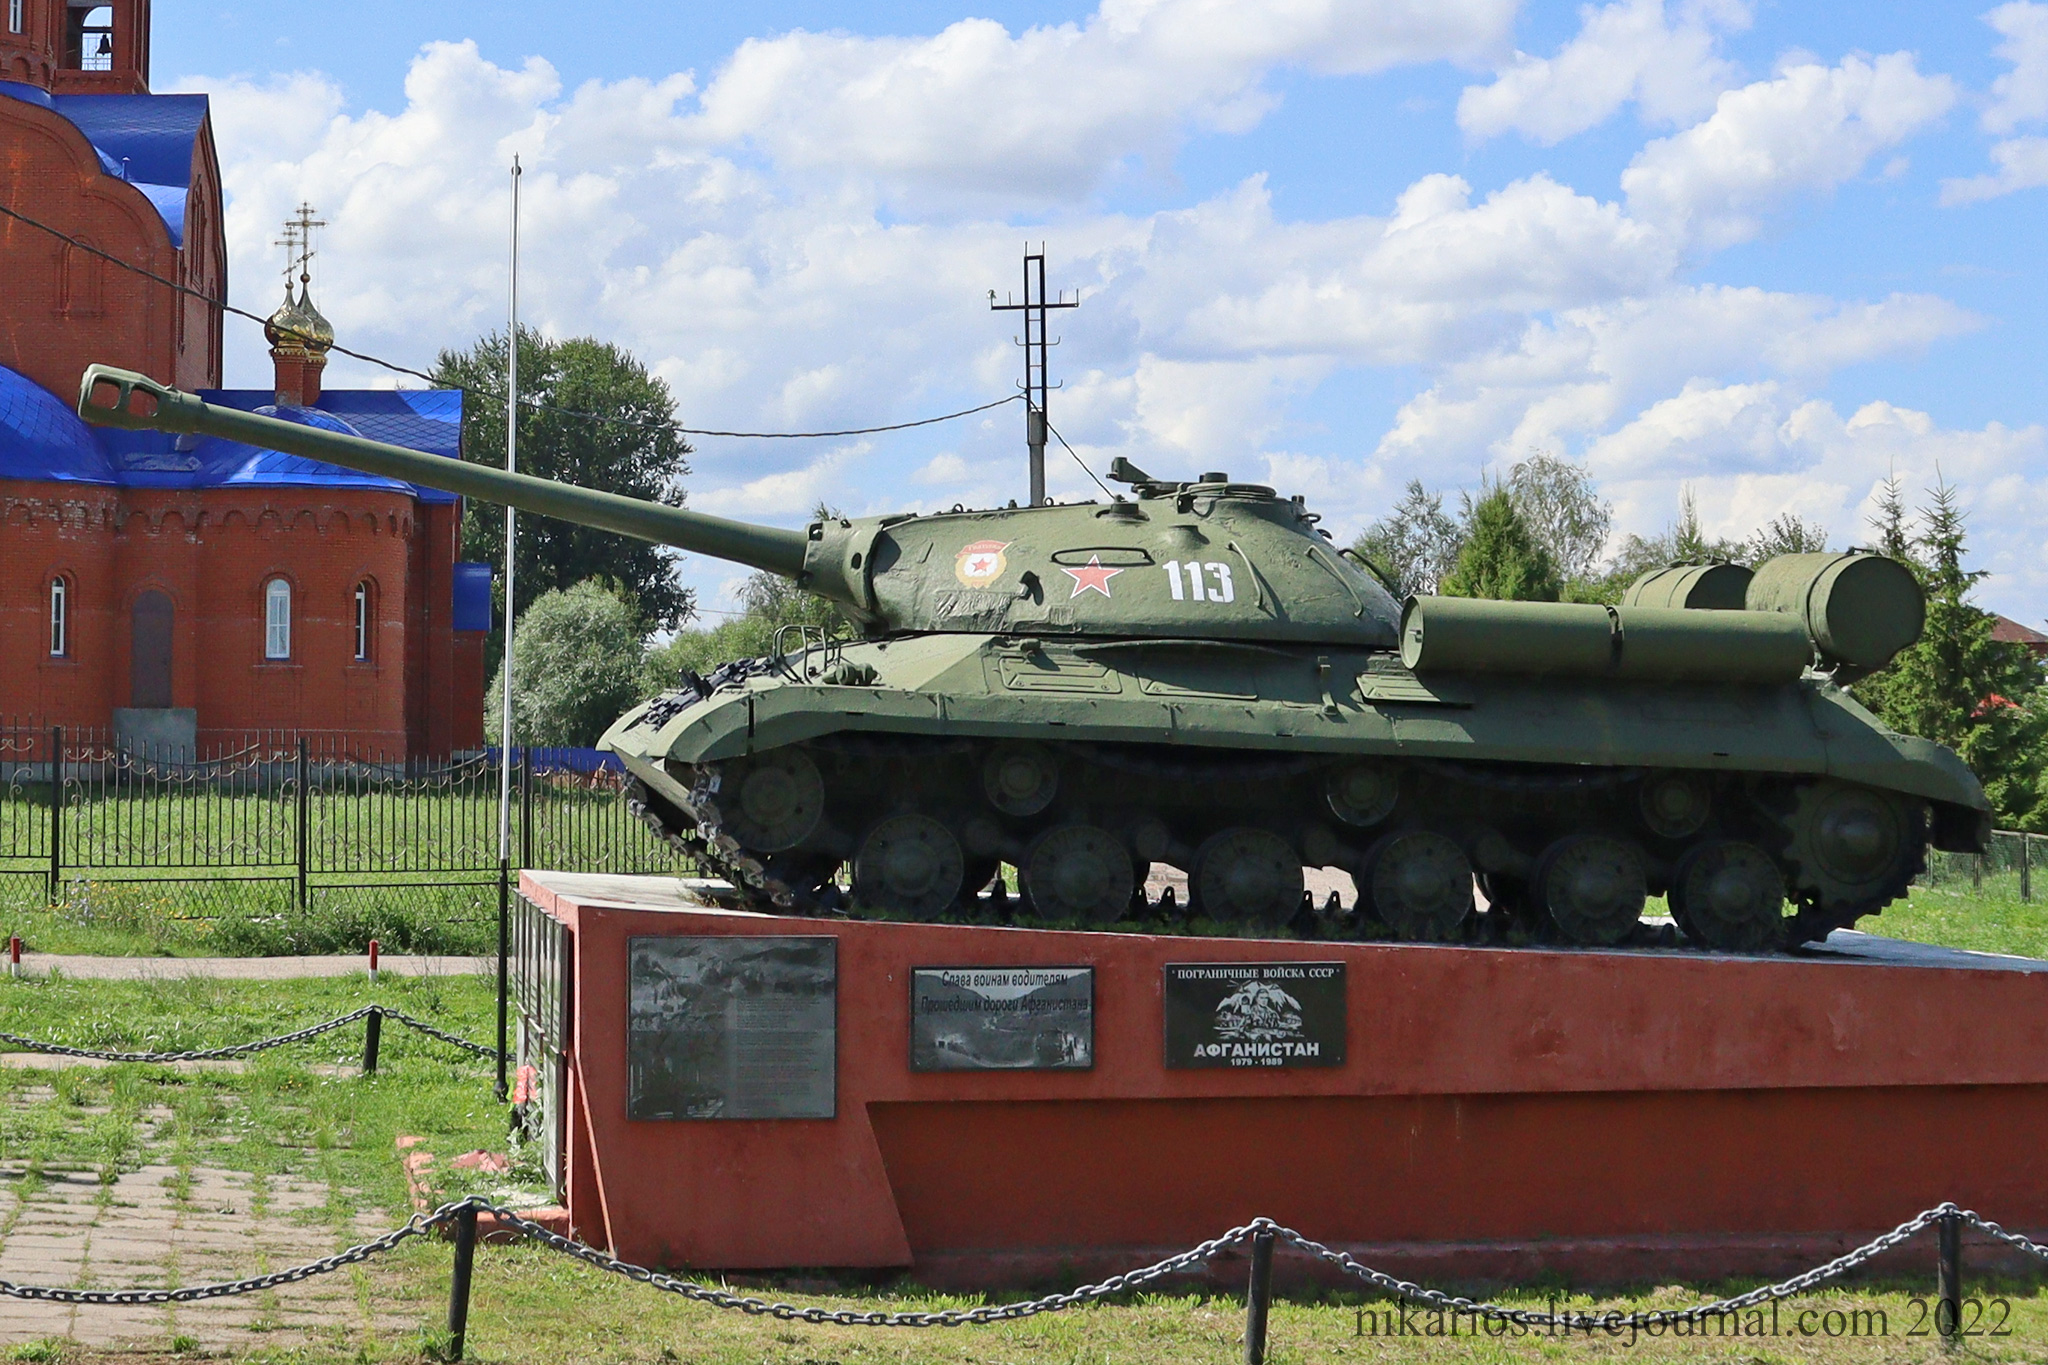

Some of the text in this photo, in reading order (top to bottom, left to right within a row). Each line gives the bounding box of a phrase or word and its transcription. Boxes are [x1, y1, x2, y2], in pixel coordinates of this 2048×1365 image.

[1162, 560, 1235, 603] 113
[942, 969, 1068, 987] Слава воинам водителям
[1177, 966, 1335, 980] ПОГРАНИЧНЫЕ ВОЙСКА СССР
[921, 995, 982, 1015] Прошедшим
[983, 995, 1019, 1015] дороги
[1193, 1042, 1320, 1058] АФГАНИСТАН
[1230, 1057, 1253, 1067] 1979
[1260, 1057, 1283, 1067] 1989
